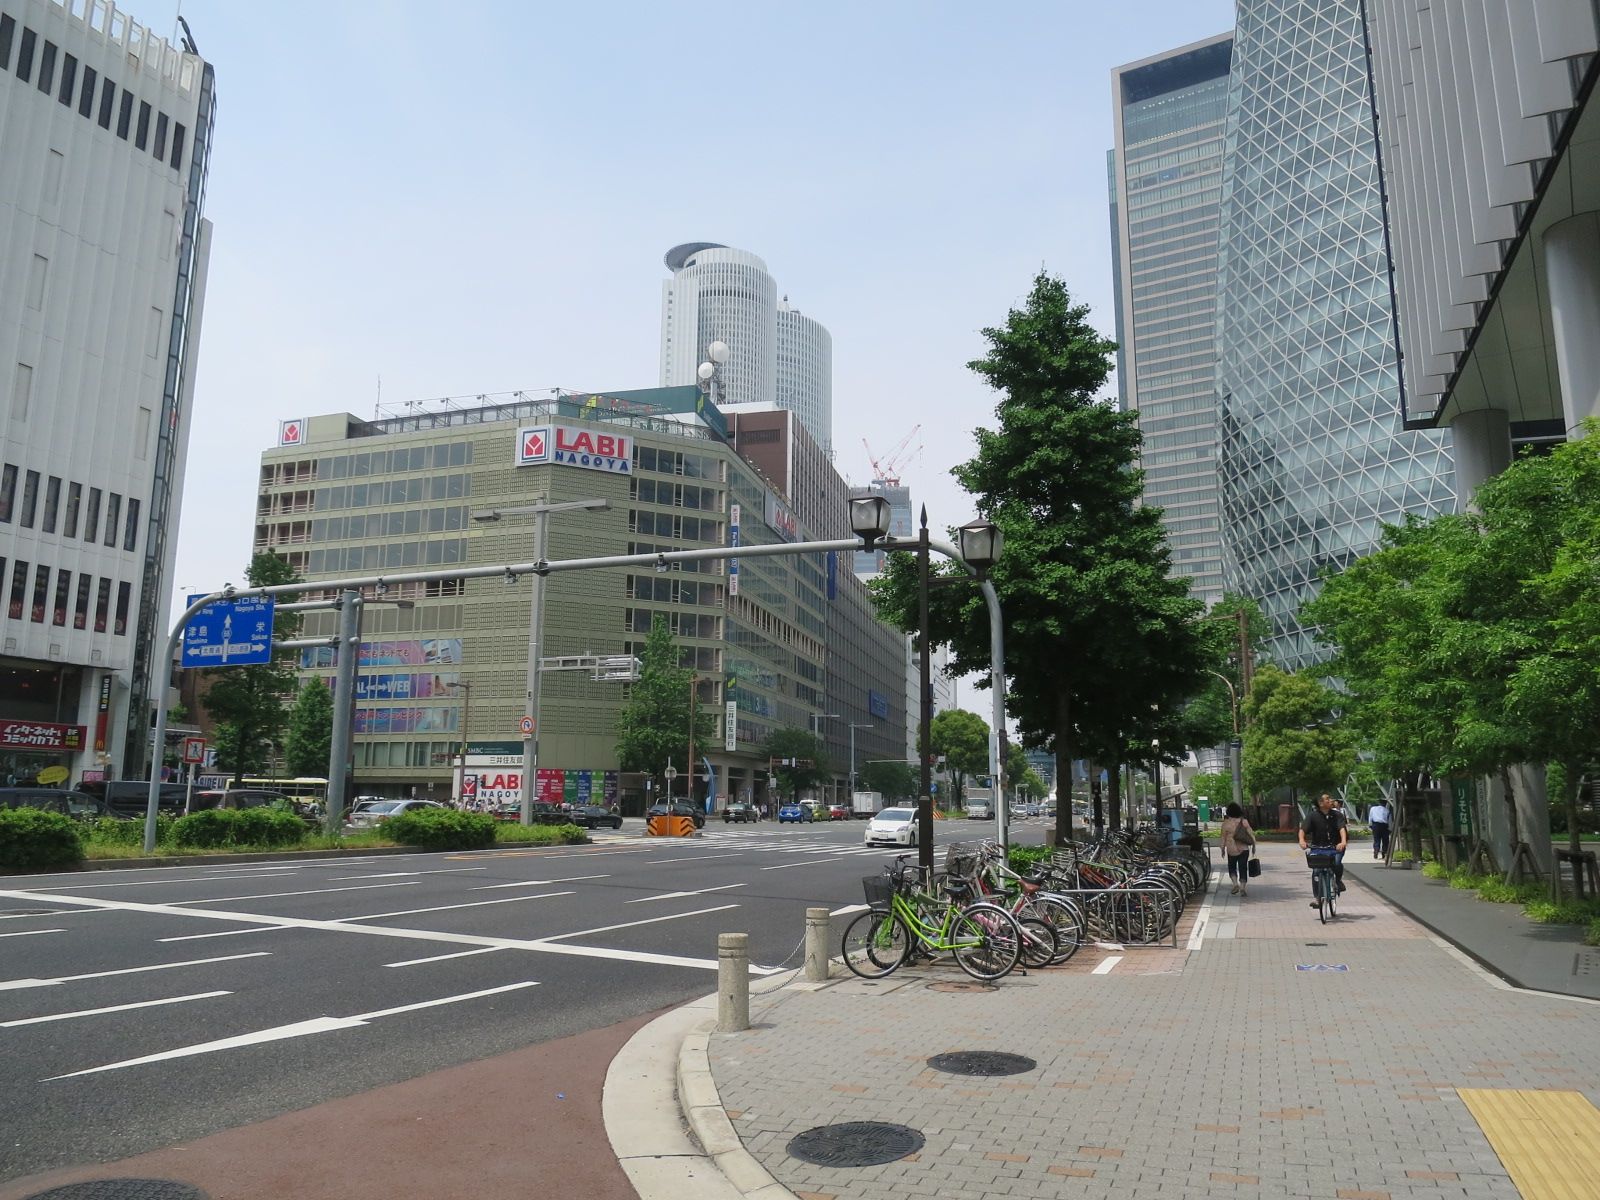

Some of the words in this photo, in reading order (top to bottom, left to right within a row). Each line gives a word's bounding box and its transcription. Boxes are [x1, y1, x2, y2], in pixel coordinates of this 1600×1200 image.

[556, 428, 625, 458] LABI
[555, 451, 629, 471] NAGOYA
[387, 680, 410, 693] WEB
[2, 733, 60, 746] コミックカフェ
[489, 756, 523, 764] 三井住友銀
[480, 790, 520, 798] NAGOY
[1457, 787, 1469, 847] りそな銀
